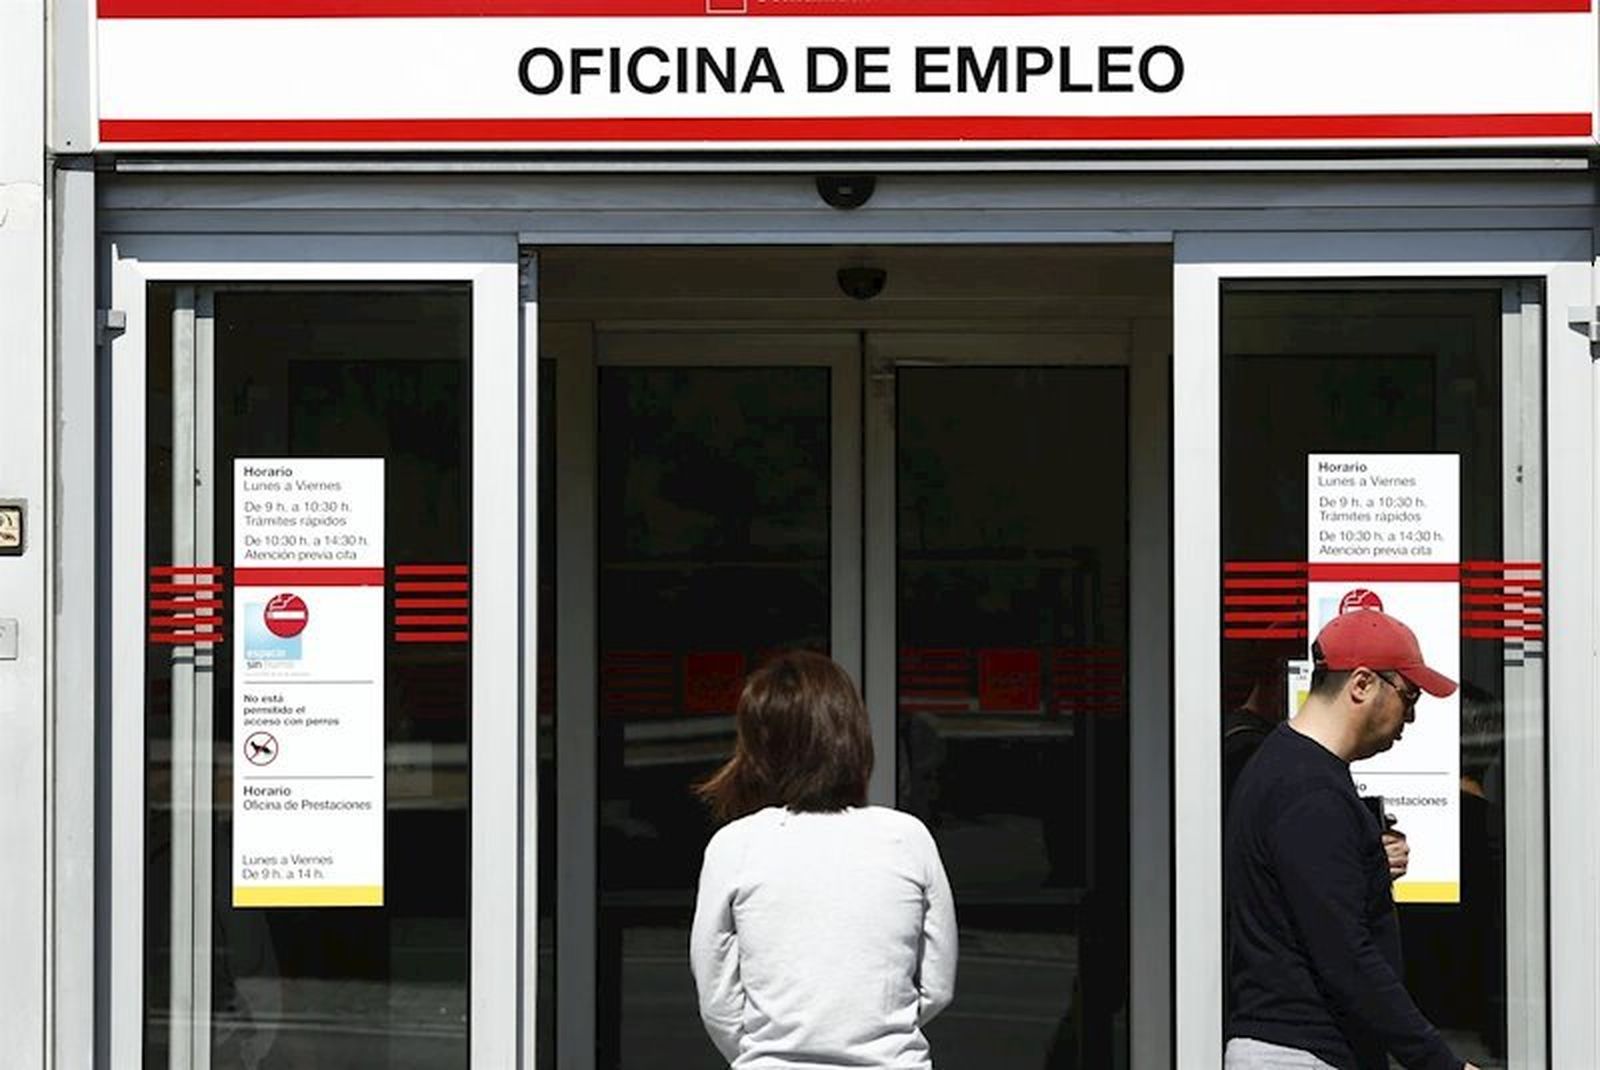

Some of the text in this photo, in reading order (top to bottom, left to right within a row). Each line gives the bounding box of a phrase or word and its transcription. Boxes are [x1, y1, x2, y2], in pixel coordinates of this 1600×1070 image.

[518, 44, 1185, 95] OFICINA DE EMPLEO
[243, 466, 293, 477] Horario
[1318, 461, 1368, 473] Horario
[243, 480, 342, 491] Lunes a Viernes
[1318, 476, 1417, 487] Lunes a Viernes
[244, 501, 352, 512] De 9 h. a 10:30 h.
[1319, 497, 1427, 508] De 9 h. a 10:30 h.
[245, 515, 347, 529] Trámites rápidos
[1320, 510, 1422, 524] Trámites rápidos
[245, 535, 369, 546] De 10:30 h. a 14:30 h.
[1319, 530, 1444, 542] De 10:30 h. a 14:30 h.
[245, 549, 357, 562] Atención previa cita
[1319, 545, 1432, 558] Atención previa cita
[247, 657, 263, 669] sin
[243, 694, 284, 703] No está
[243, 706, 306, 716] permitido el
[243, 718, 340, 728] acceso con perros
[243, 786, 291, 796] Horario
[243, 799, 372, 811] Oficina de Prestaciones
[1384, 796, 1448, 806] restaciones
[242, 854, 334, 865] Lunes a Viernes
[242, 868, 324, 879] De 9 h. a 14 h.
